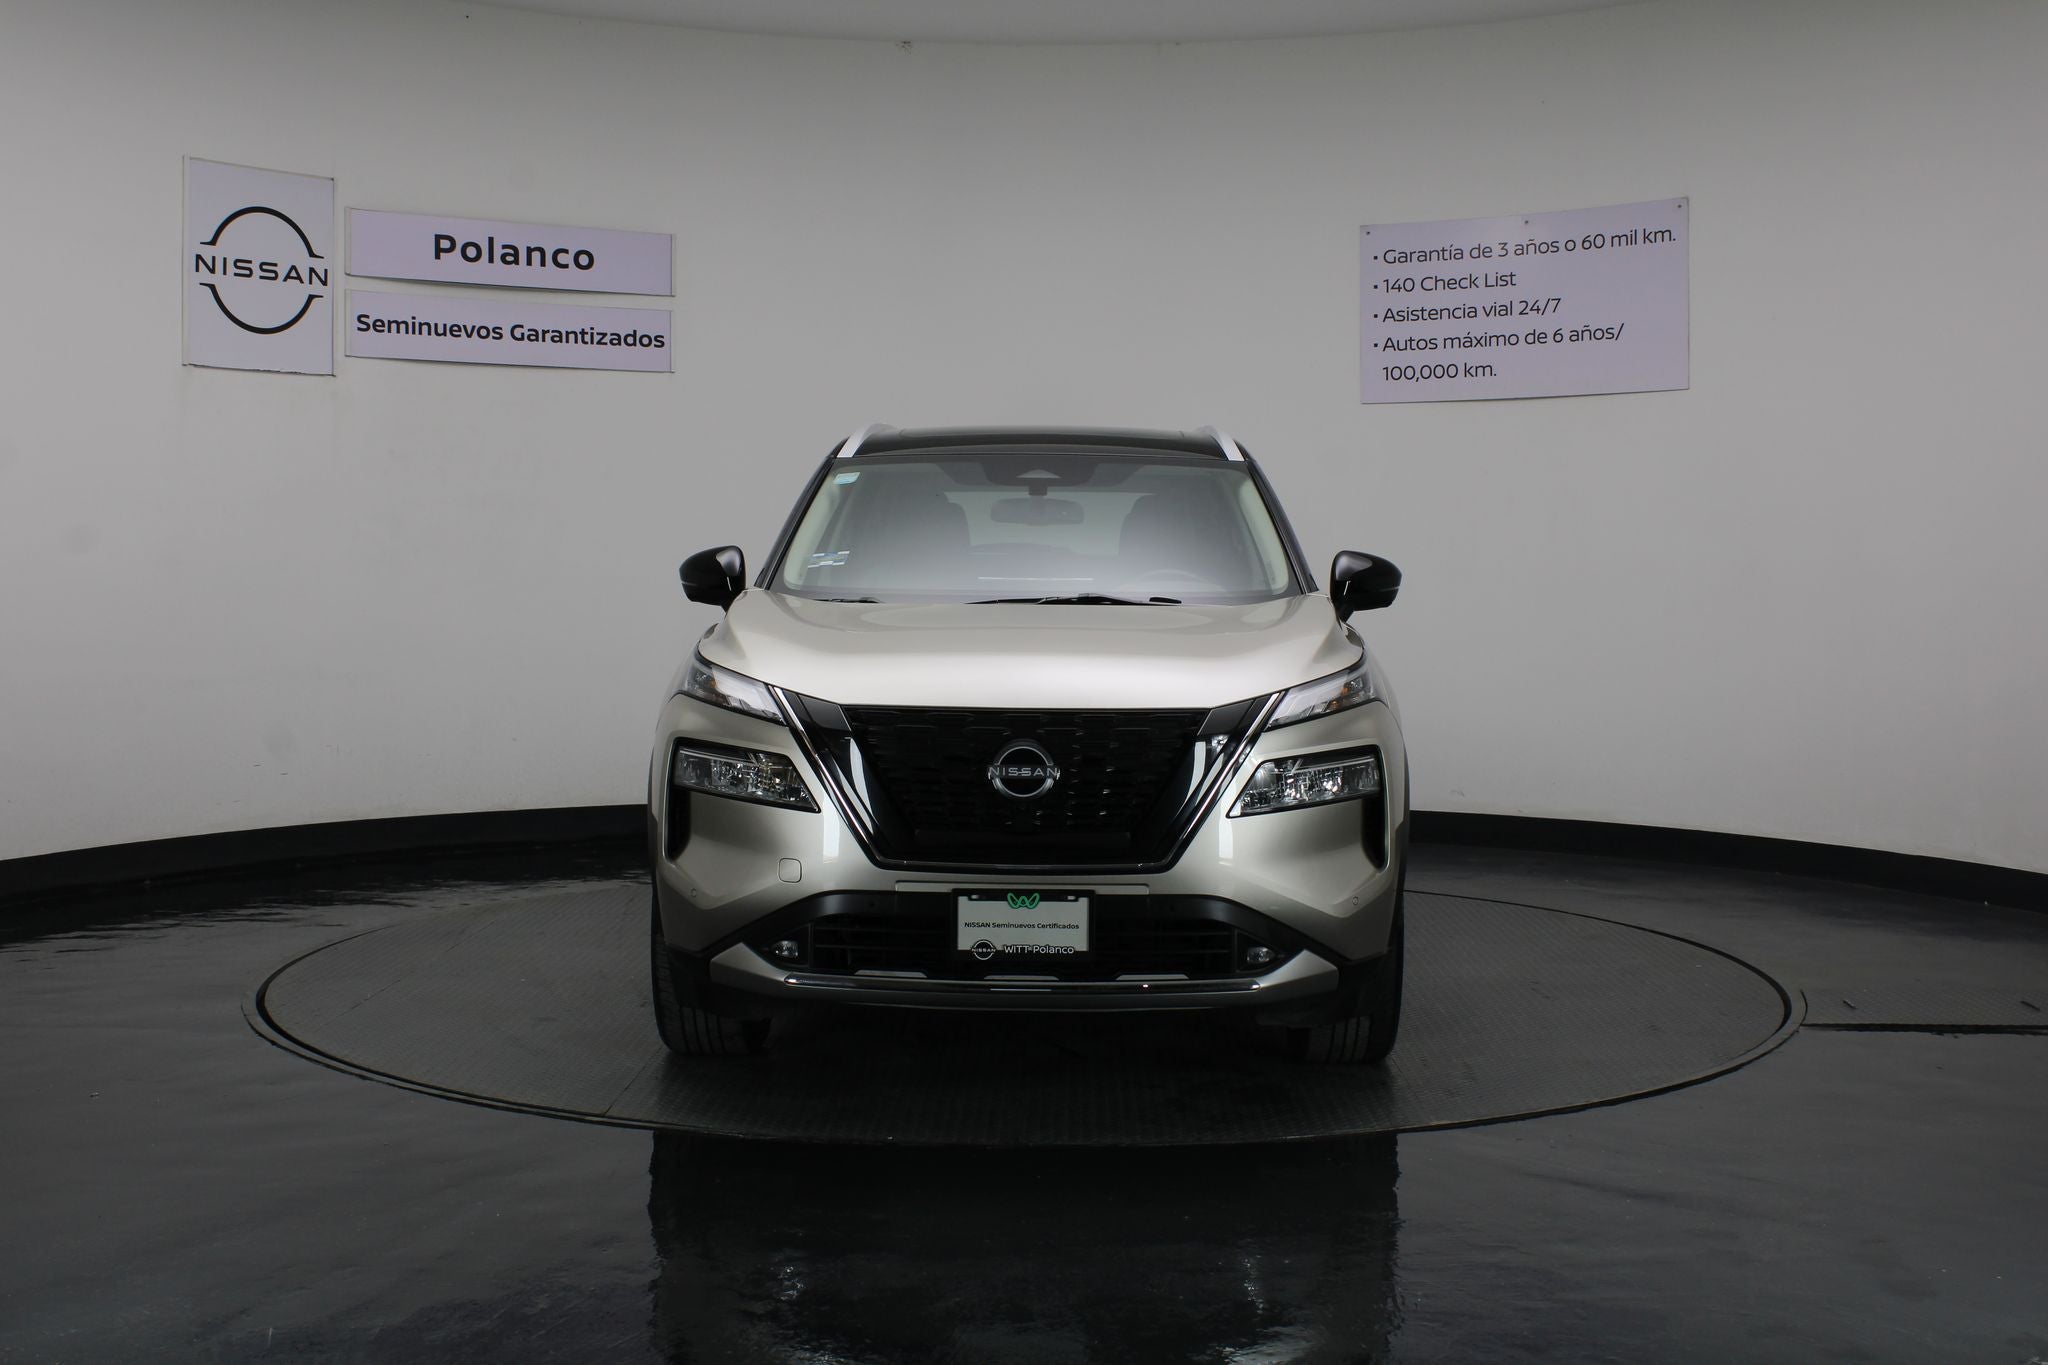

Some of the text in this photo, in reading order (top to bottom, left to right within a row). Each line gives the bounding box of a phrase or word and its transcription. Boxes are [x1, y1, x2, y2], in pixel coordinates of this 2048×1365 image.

[434, 234, 595, 270] Polanco
[1383, 227, 1676, 264] Garantía de 3 años o 60 mil km.
[195, 253, 328, 287] NISSAN
[1383, 272, 1516, 293] 140 Check List
[1383, 298, 1561, 322] Asistencia vial 24/7
[356, 313, 665, 348] Seminuevos Garantizados
[1383, 323, 1624, 351] Autos máximo de 6 años/
[1382, 363, 1497, 382] 100,000 km.
[989, 767, 1058, 777] NISSAN
[1033, 945, 1074, 954] Polanco
